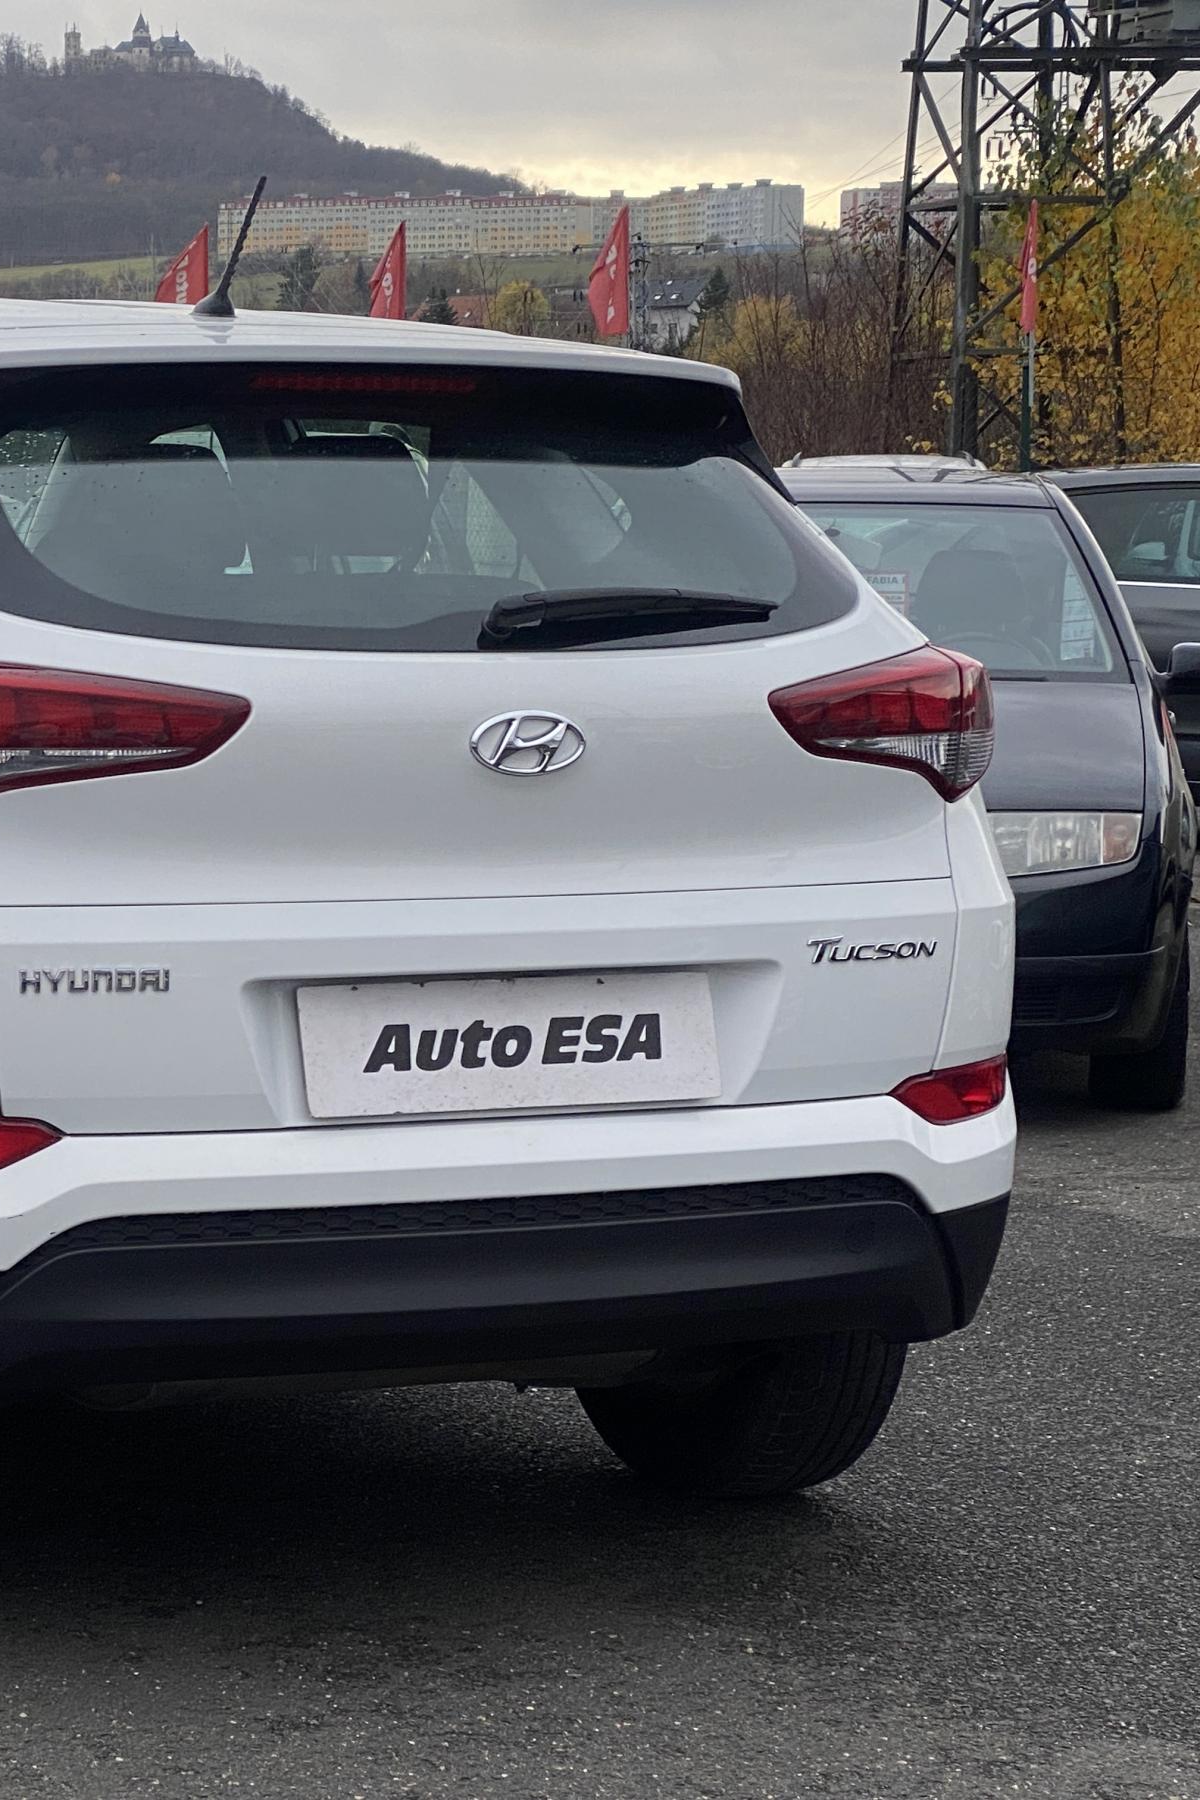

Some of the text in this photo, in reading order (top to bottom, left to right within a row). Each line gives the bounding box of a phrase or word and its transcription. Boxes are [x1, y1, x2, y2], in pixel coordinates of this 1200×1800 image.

[19, 968, 170, 994] HYUNDAI
[363, 1013, 662, 1073] Auto ESA
